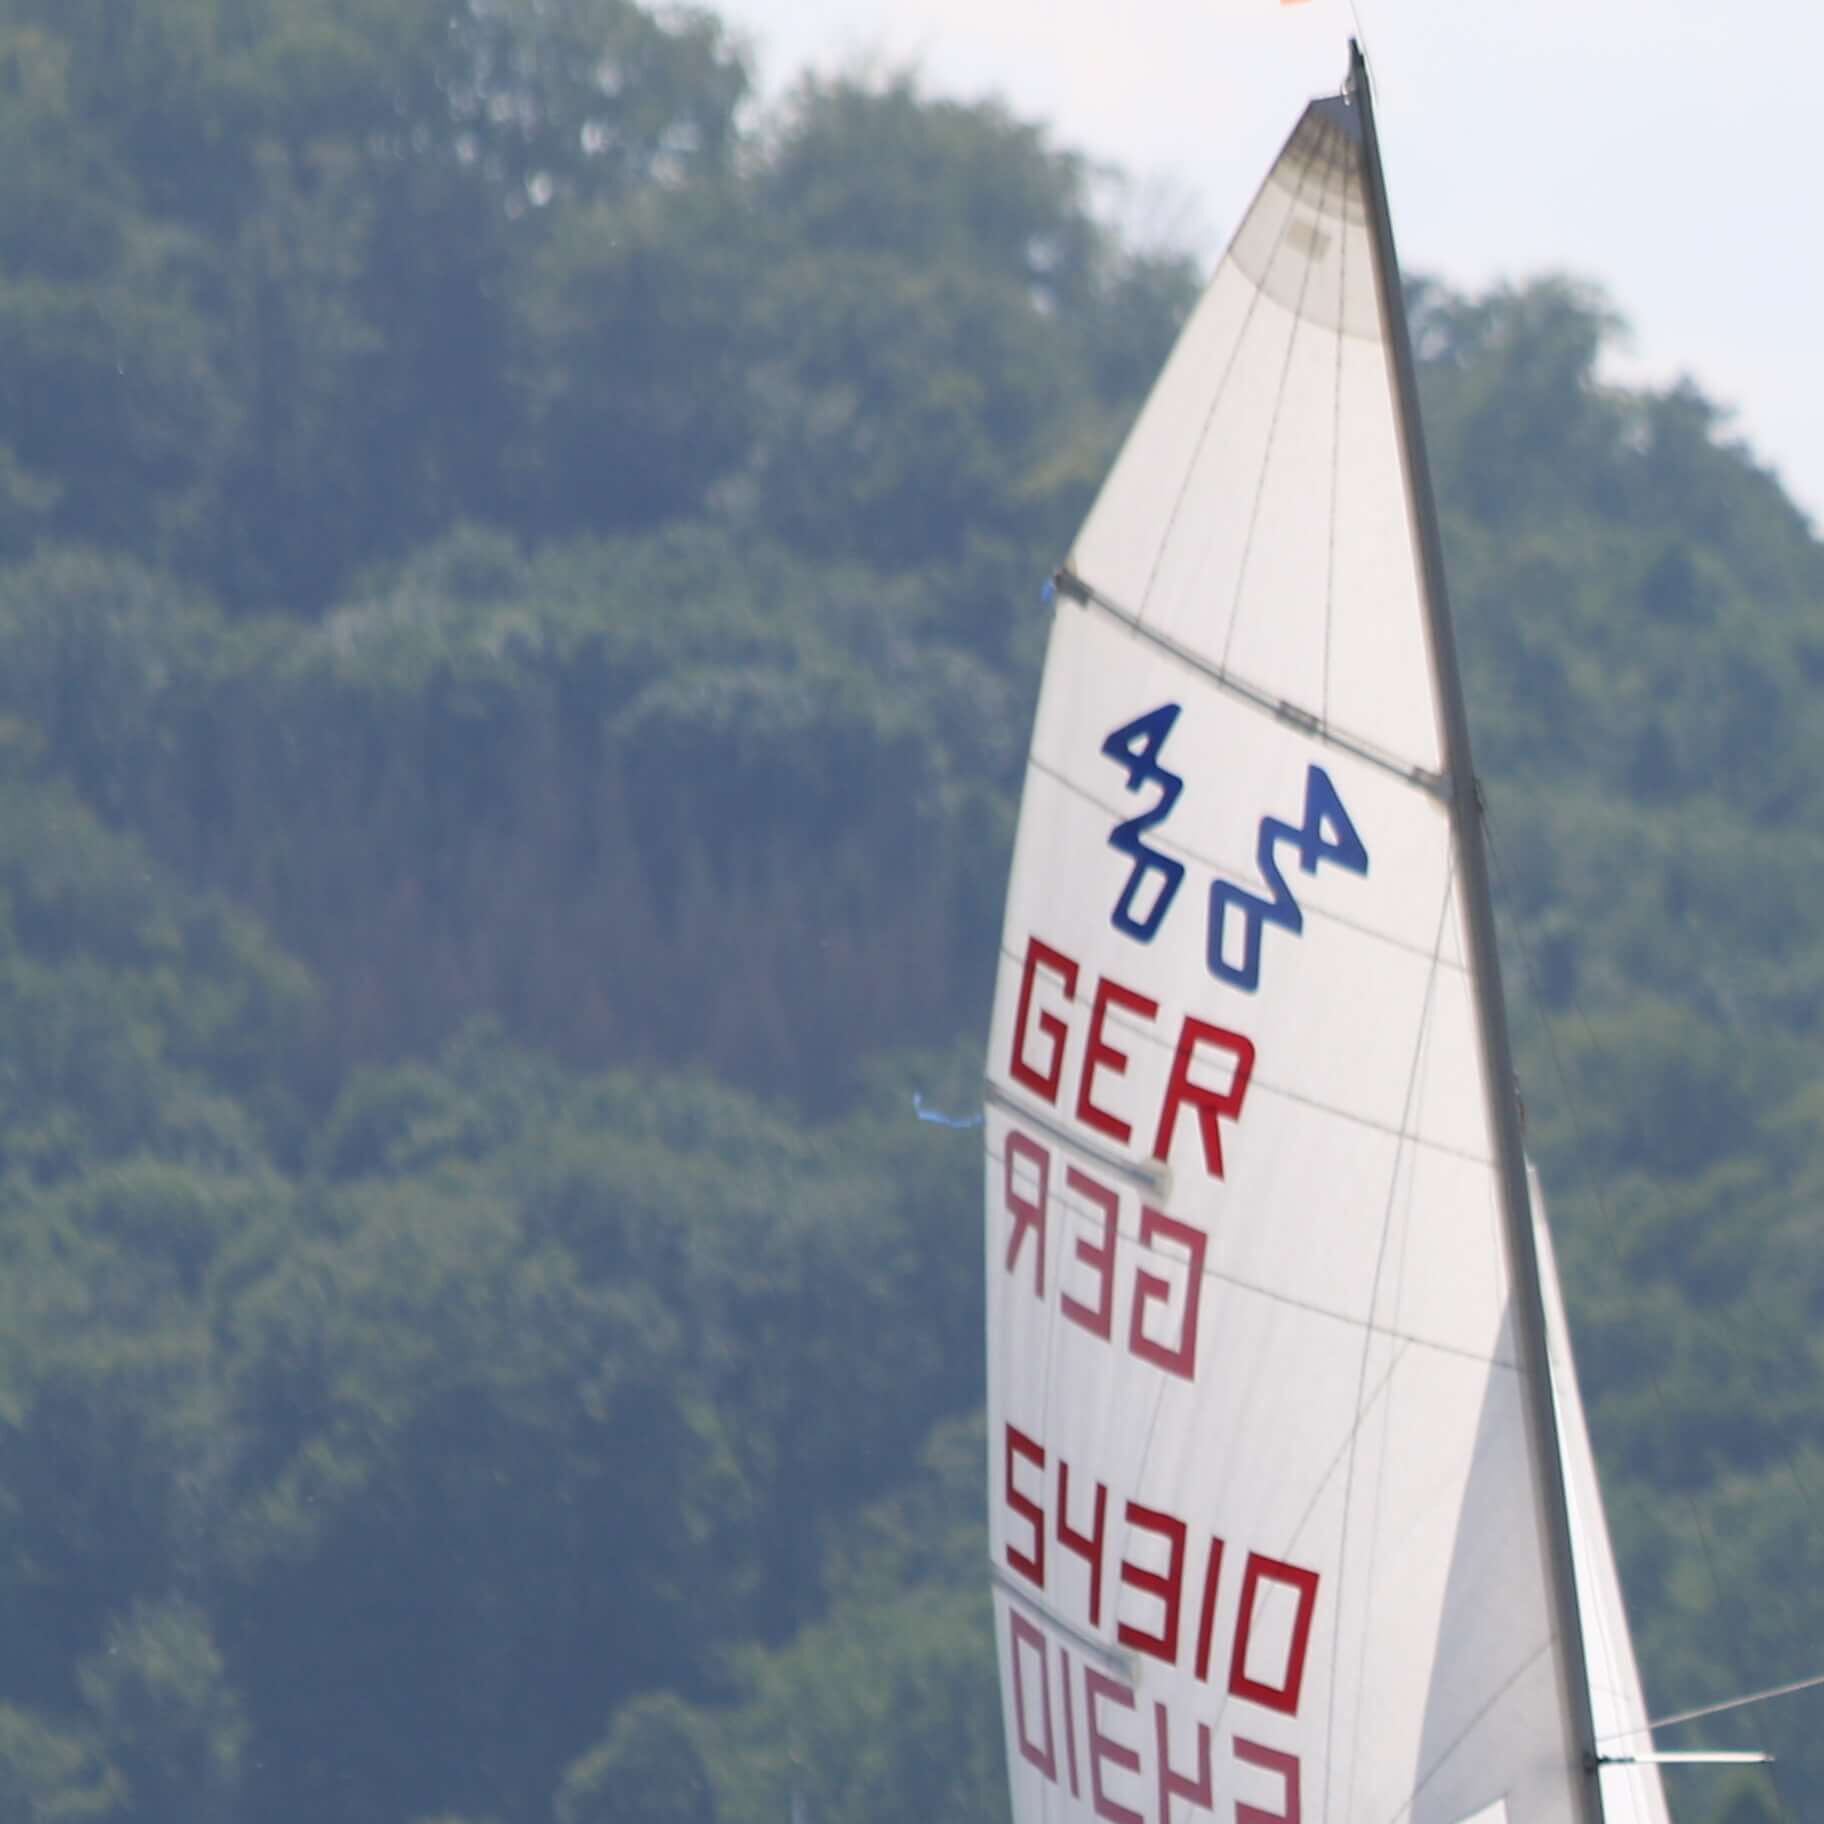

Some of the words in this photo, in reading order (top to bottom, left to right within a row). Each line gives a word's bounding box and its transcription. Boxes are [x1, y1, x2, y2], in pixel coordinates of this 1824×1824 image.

[1101, 703, 1186, 944] 420
[1007, 936, 1257, 1181] GER
[1005, 1422, 1321, 1718] 54310
